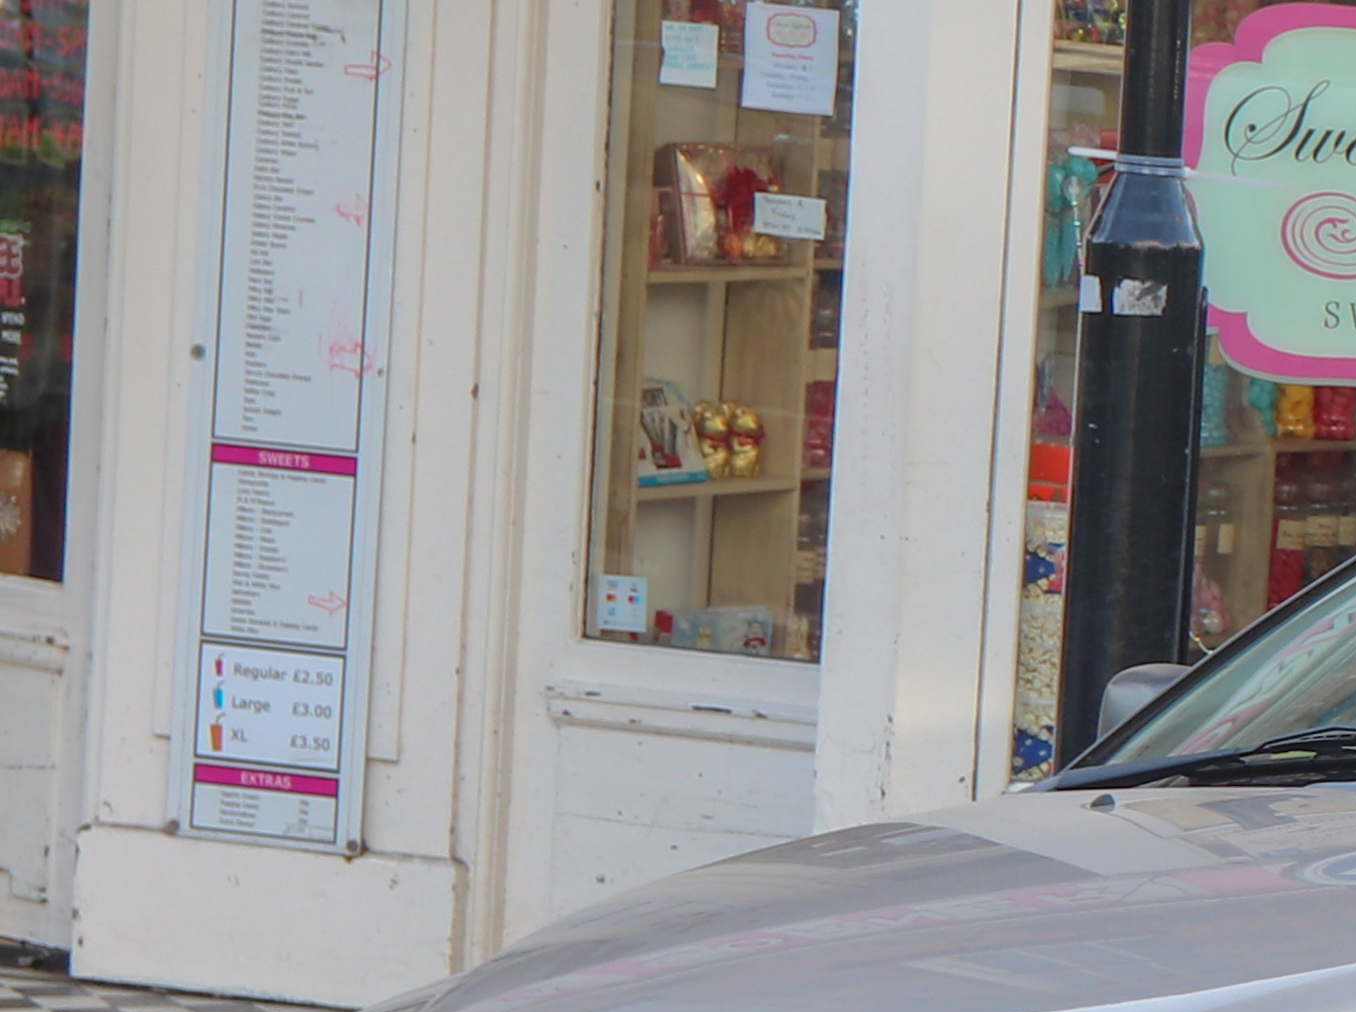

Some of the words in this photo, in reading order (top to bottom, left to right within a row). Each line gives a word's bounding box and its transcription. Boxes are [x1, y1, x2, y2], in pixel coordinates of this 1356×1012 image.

[258, 451, 310, 469] SWEETS
[232, 662, 287, 681] Regular
[292, 670, 334, 686] £2.50
[231, 696, 271, 713] Large
[291, 702, 332, 719] £3.00
[230, 728, 247, 743] XL
[290, 734, 331, 751] £3.50
[240, 771, 292, 788] EXTRAS
